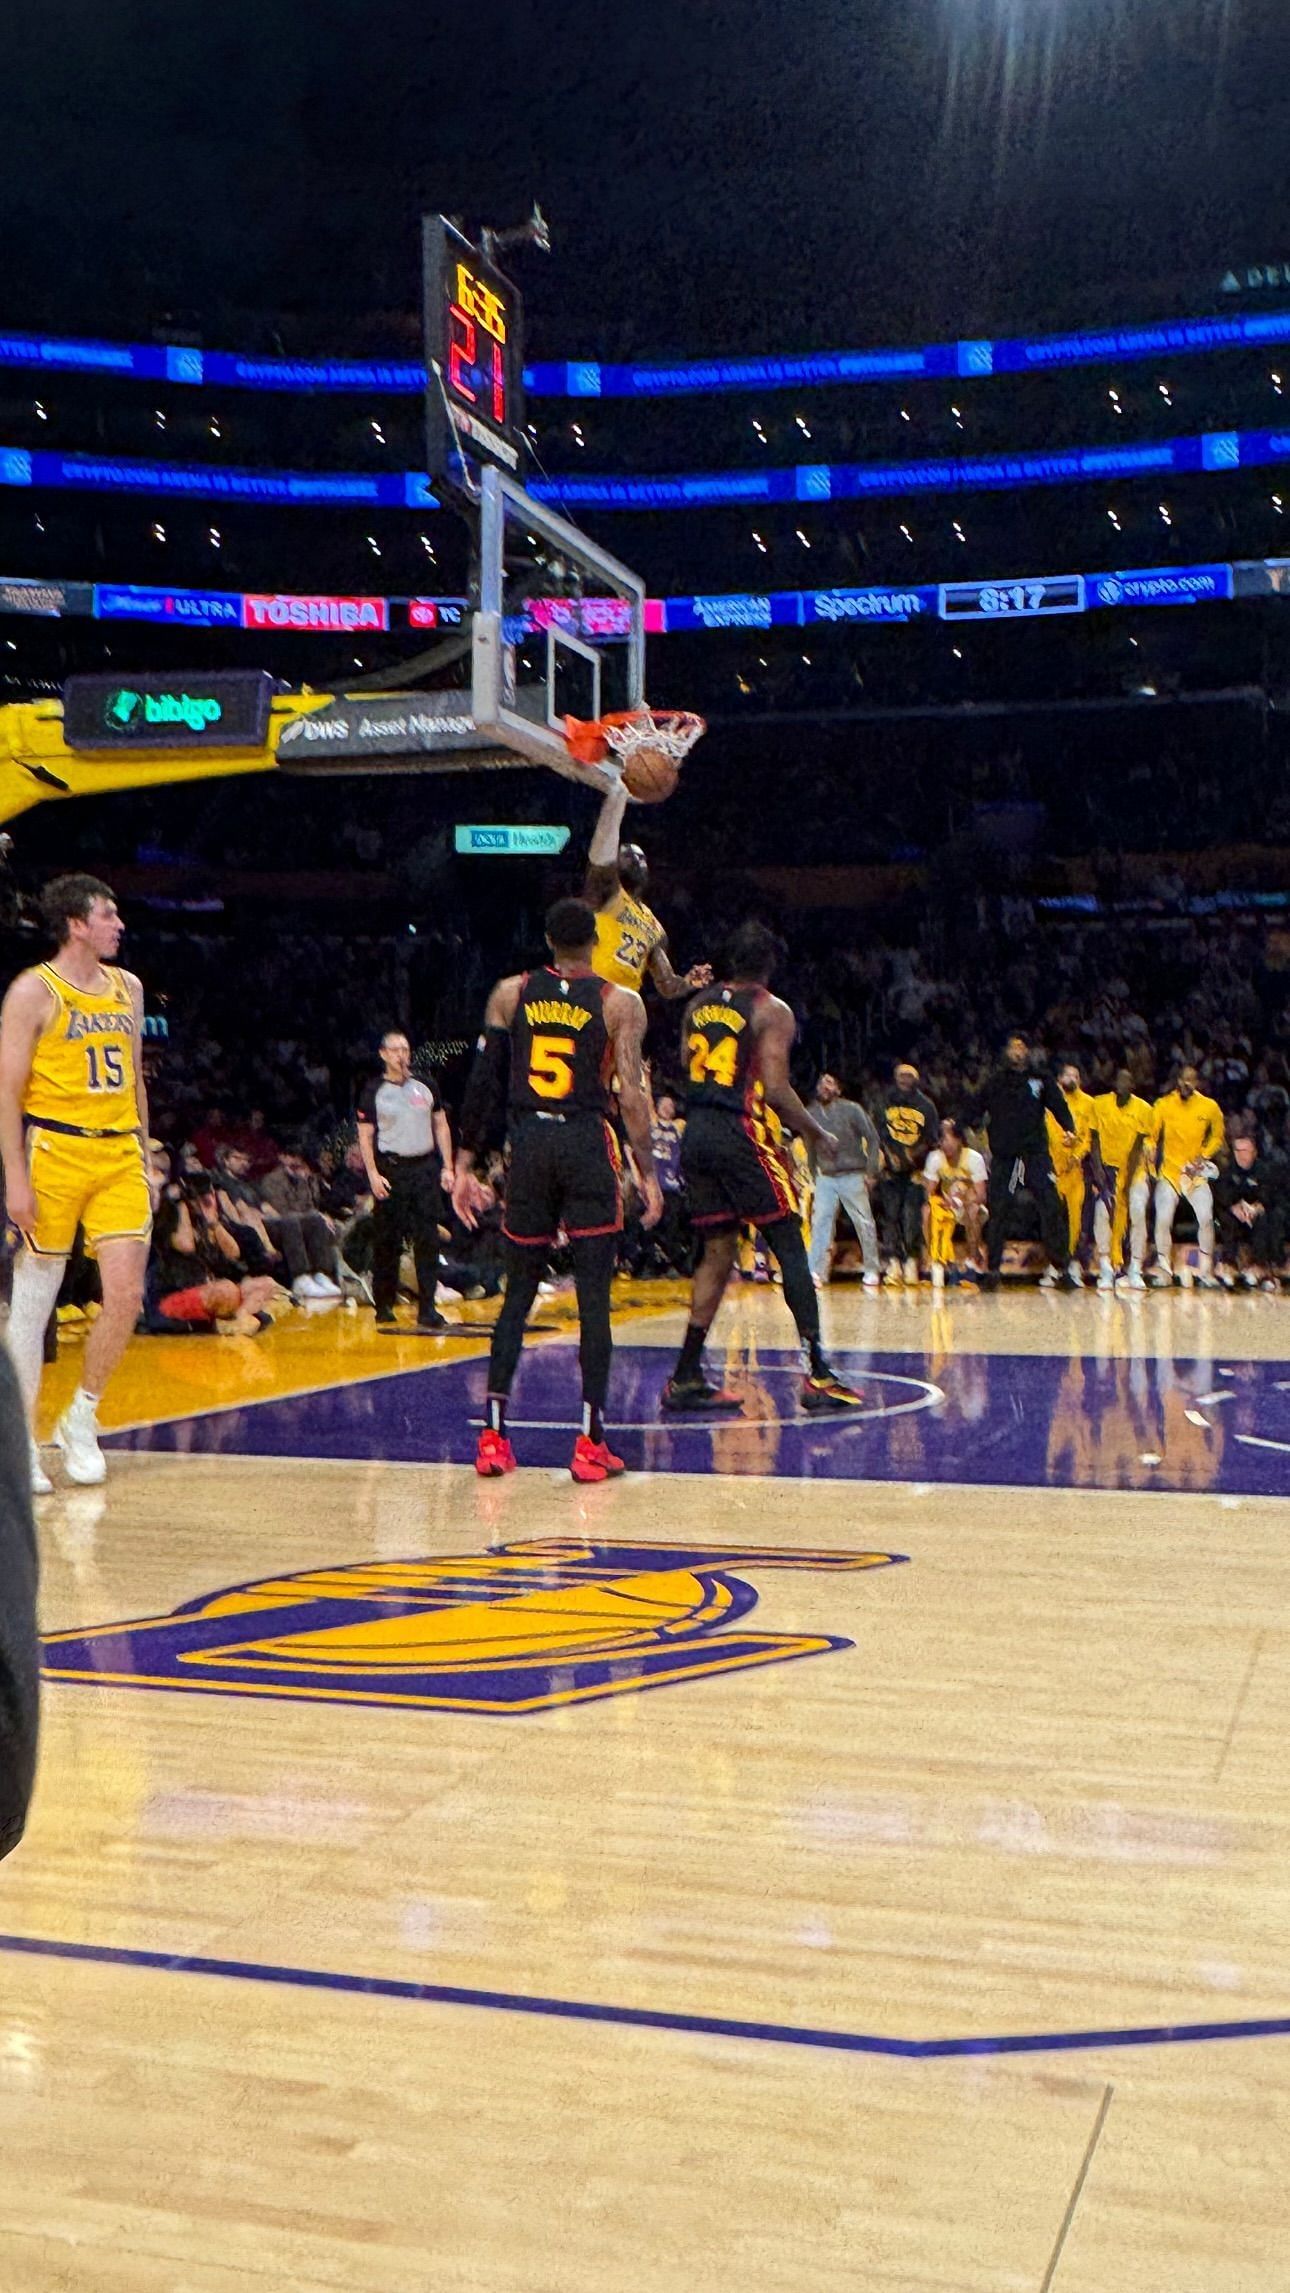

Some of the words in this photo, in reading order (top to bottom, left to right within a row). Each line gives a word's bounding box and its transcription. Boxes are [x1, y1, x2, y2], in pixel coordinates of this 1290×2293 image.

[450, 303, 505, 424] 21
[175, 598, 238, 618] ULTRA
[250, 600, 379, 627] TOSHIBA
[814, 591, 921, 621] Spectrum
[977, 585, 1046, 612] 8:17
[145, 693, 221, 731] bibigo
[304, 719, 349, 741] DWS
[616, 931, 648, 969] 23
[524, 1000, 592, 1032] MURRAY
[84, 1045, 124, 1091] 15
[527, 1035, 577, 1100] 5
[687, 1032, 738, 1088] 24
